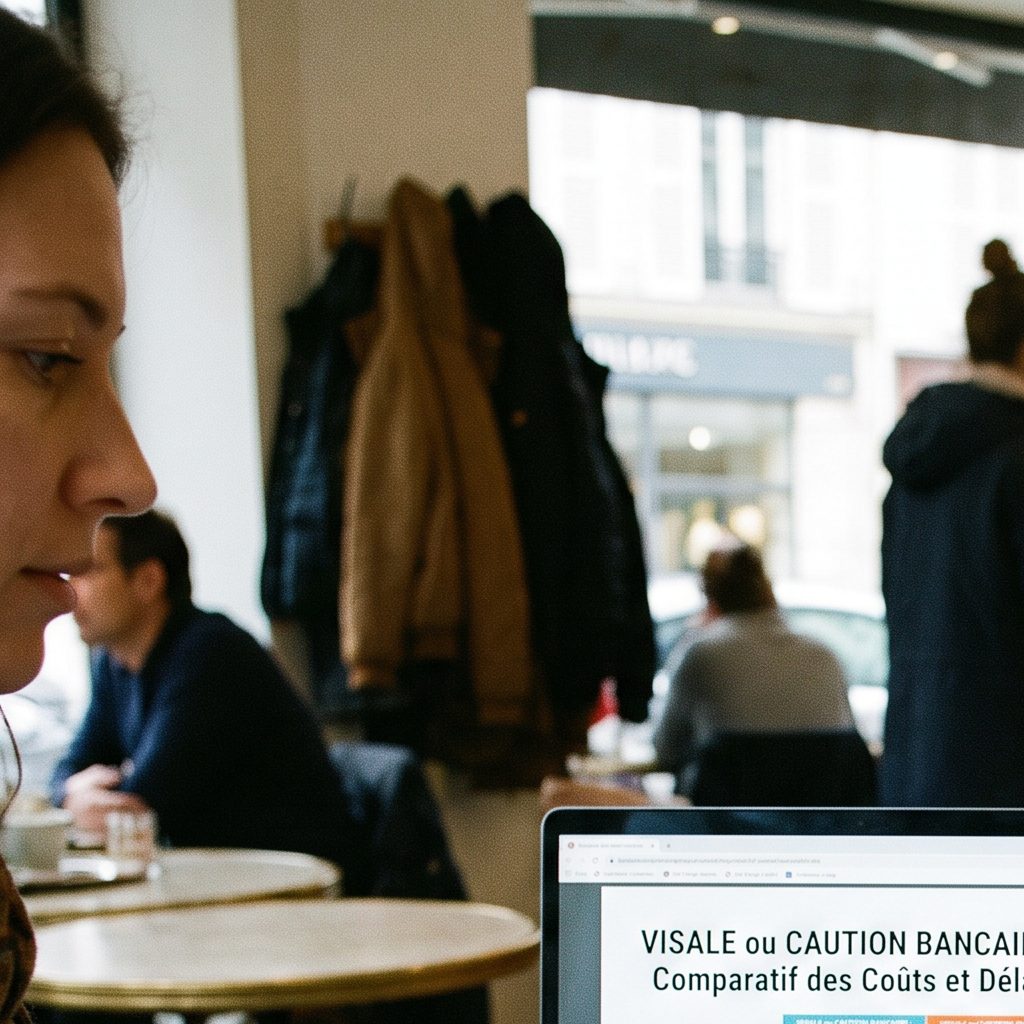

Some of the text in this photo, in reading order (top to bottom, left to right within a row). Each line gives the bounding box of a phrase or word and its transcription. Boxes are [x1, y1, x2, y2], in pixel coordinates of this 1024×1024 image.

[641, 929, 736, 954] VISALE
[745, 936, 776, 955] ou
[786, 930, 906, 956] CAUTION
[653, 965, 798, 998] Comparatif
[807, 965, 852, 992] des
[862, 966, 936, 992] Coûts
[946, 969, 970, 993] et
